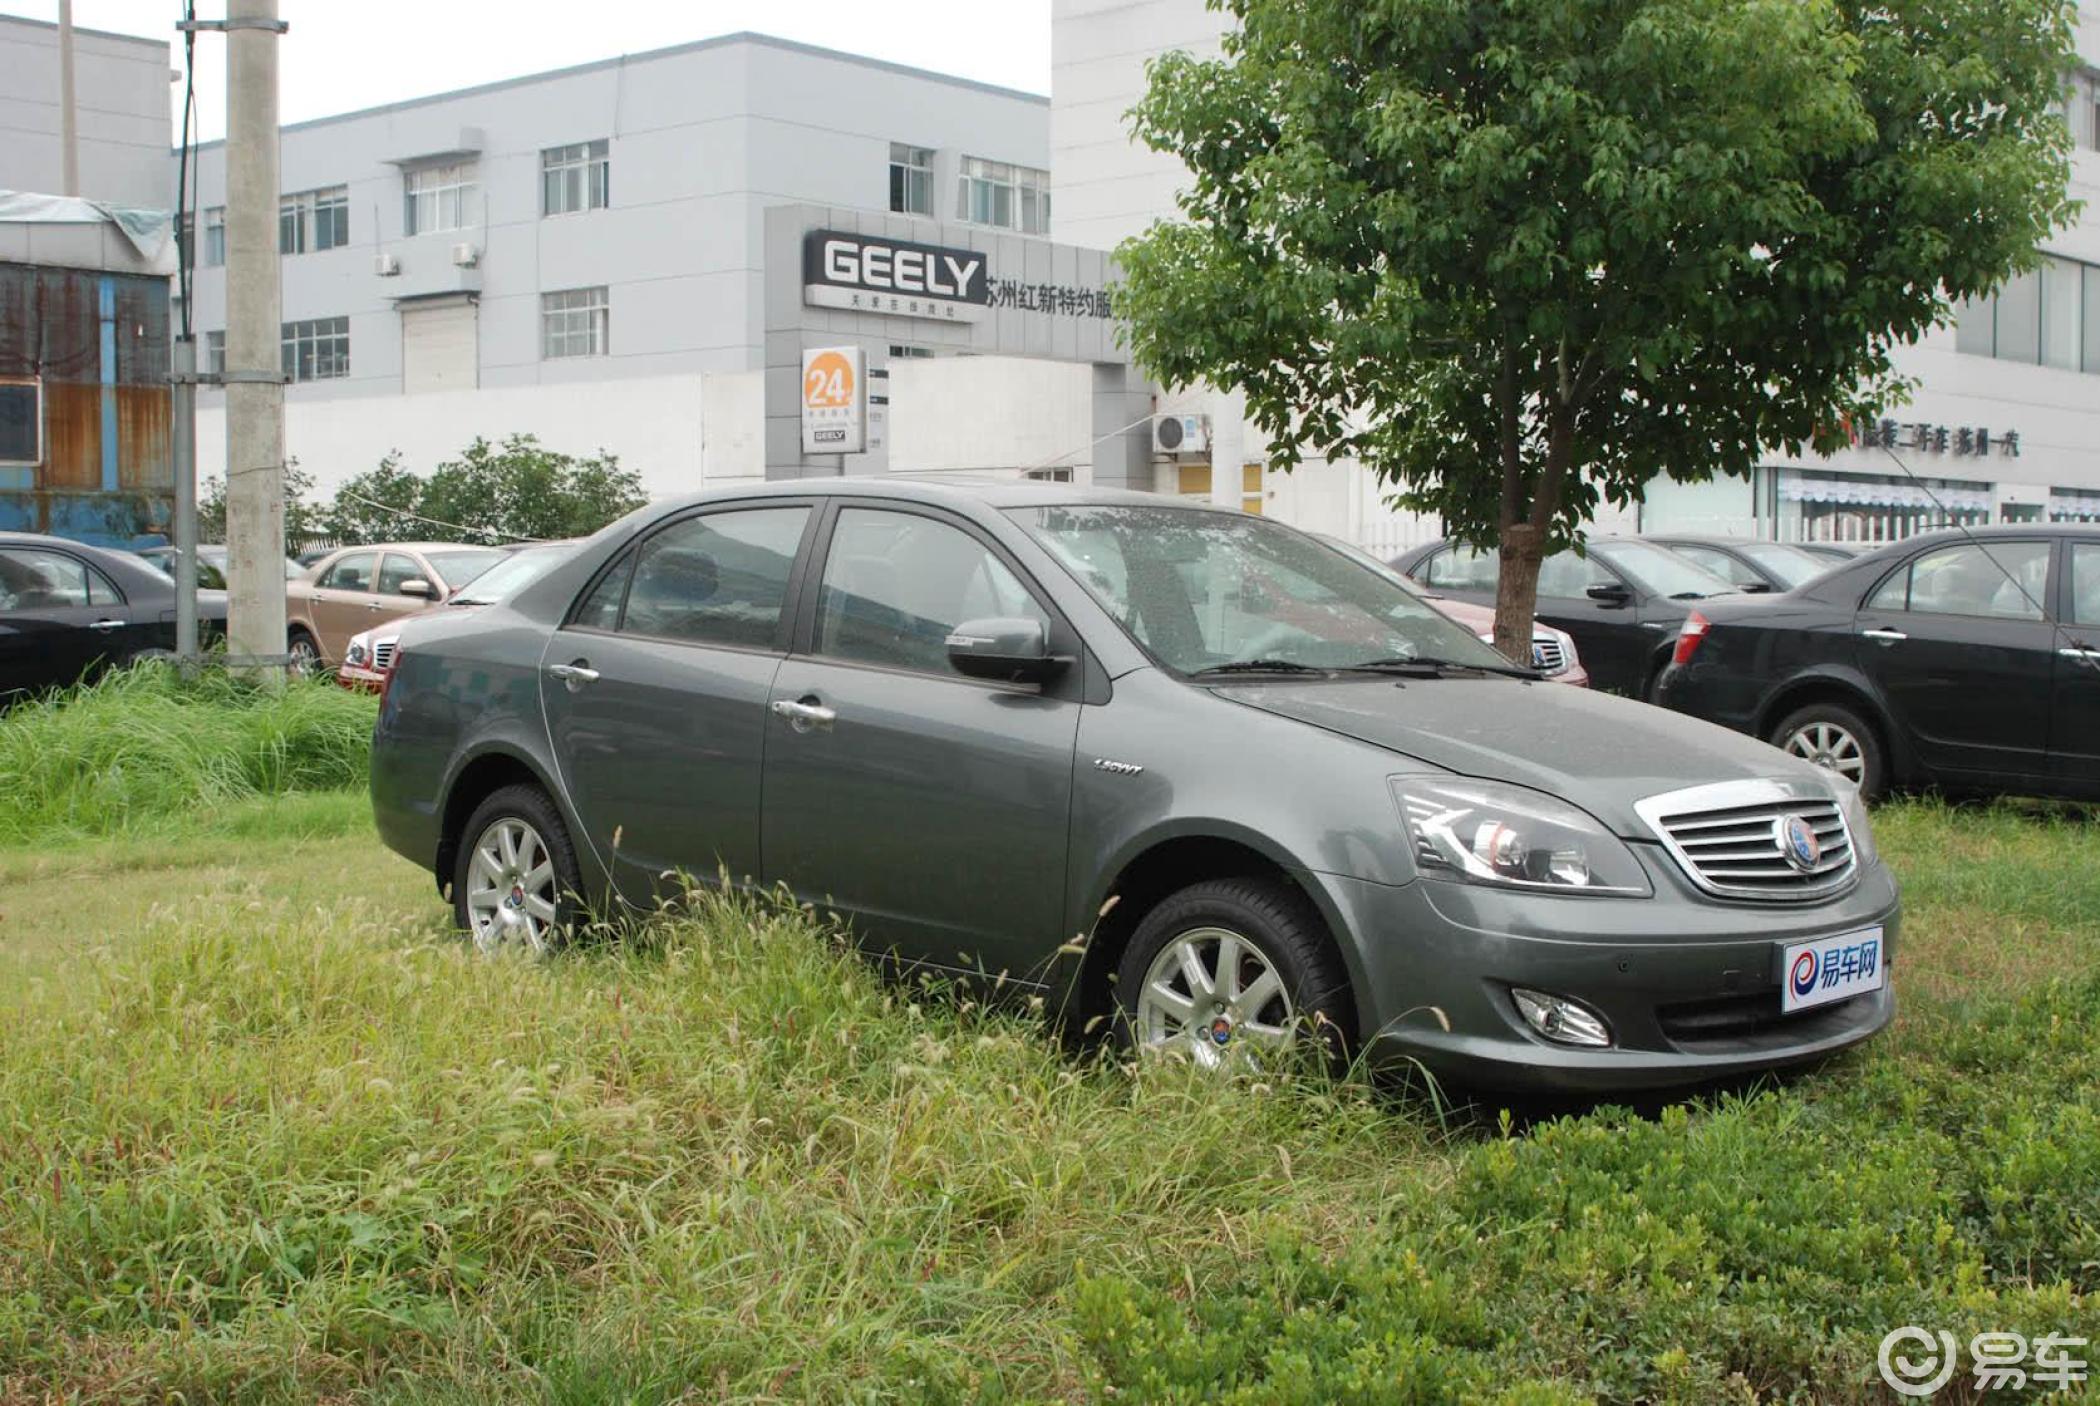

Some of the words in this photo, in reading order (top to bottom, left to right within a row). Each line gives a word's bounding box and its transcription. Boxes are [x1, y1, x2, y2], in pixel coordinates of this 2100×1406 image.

[825, 240, 979, 297] GEELY
[1821, 940, 1877, 989] 易车网
